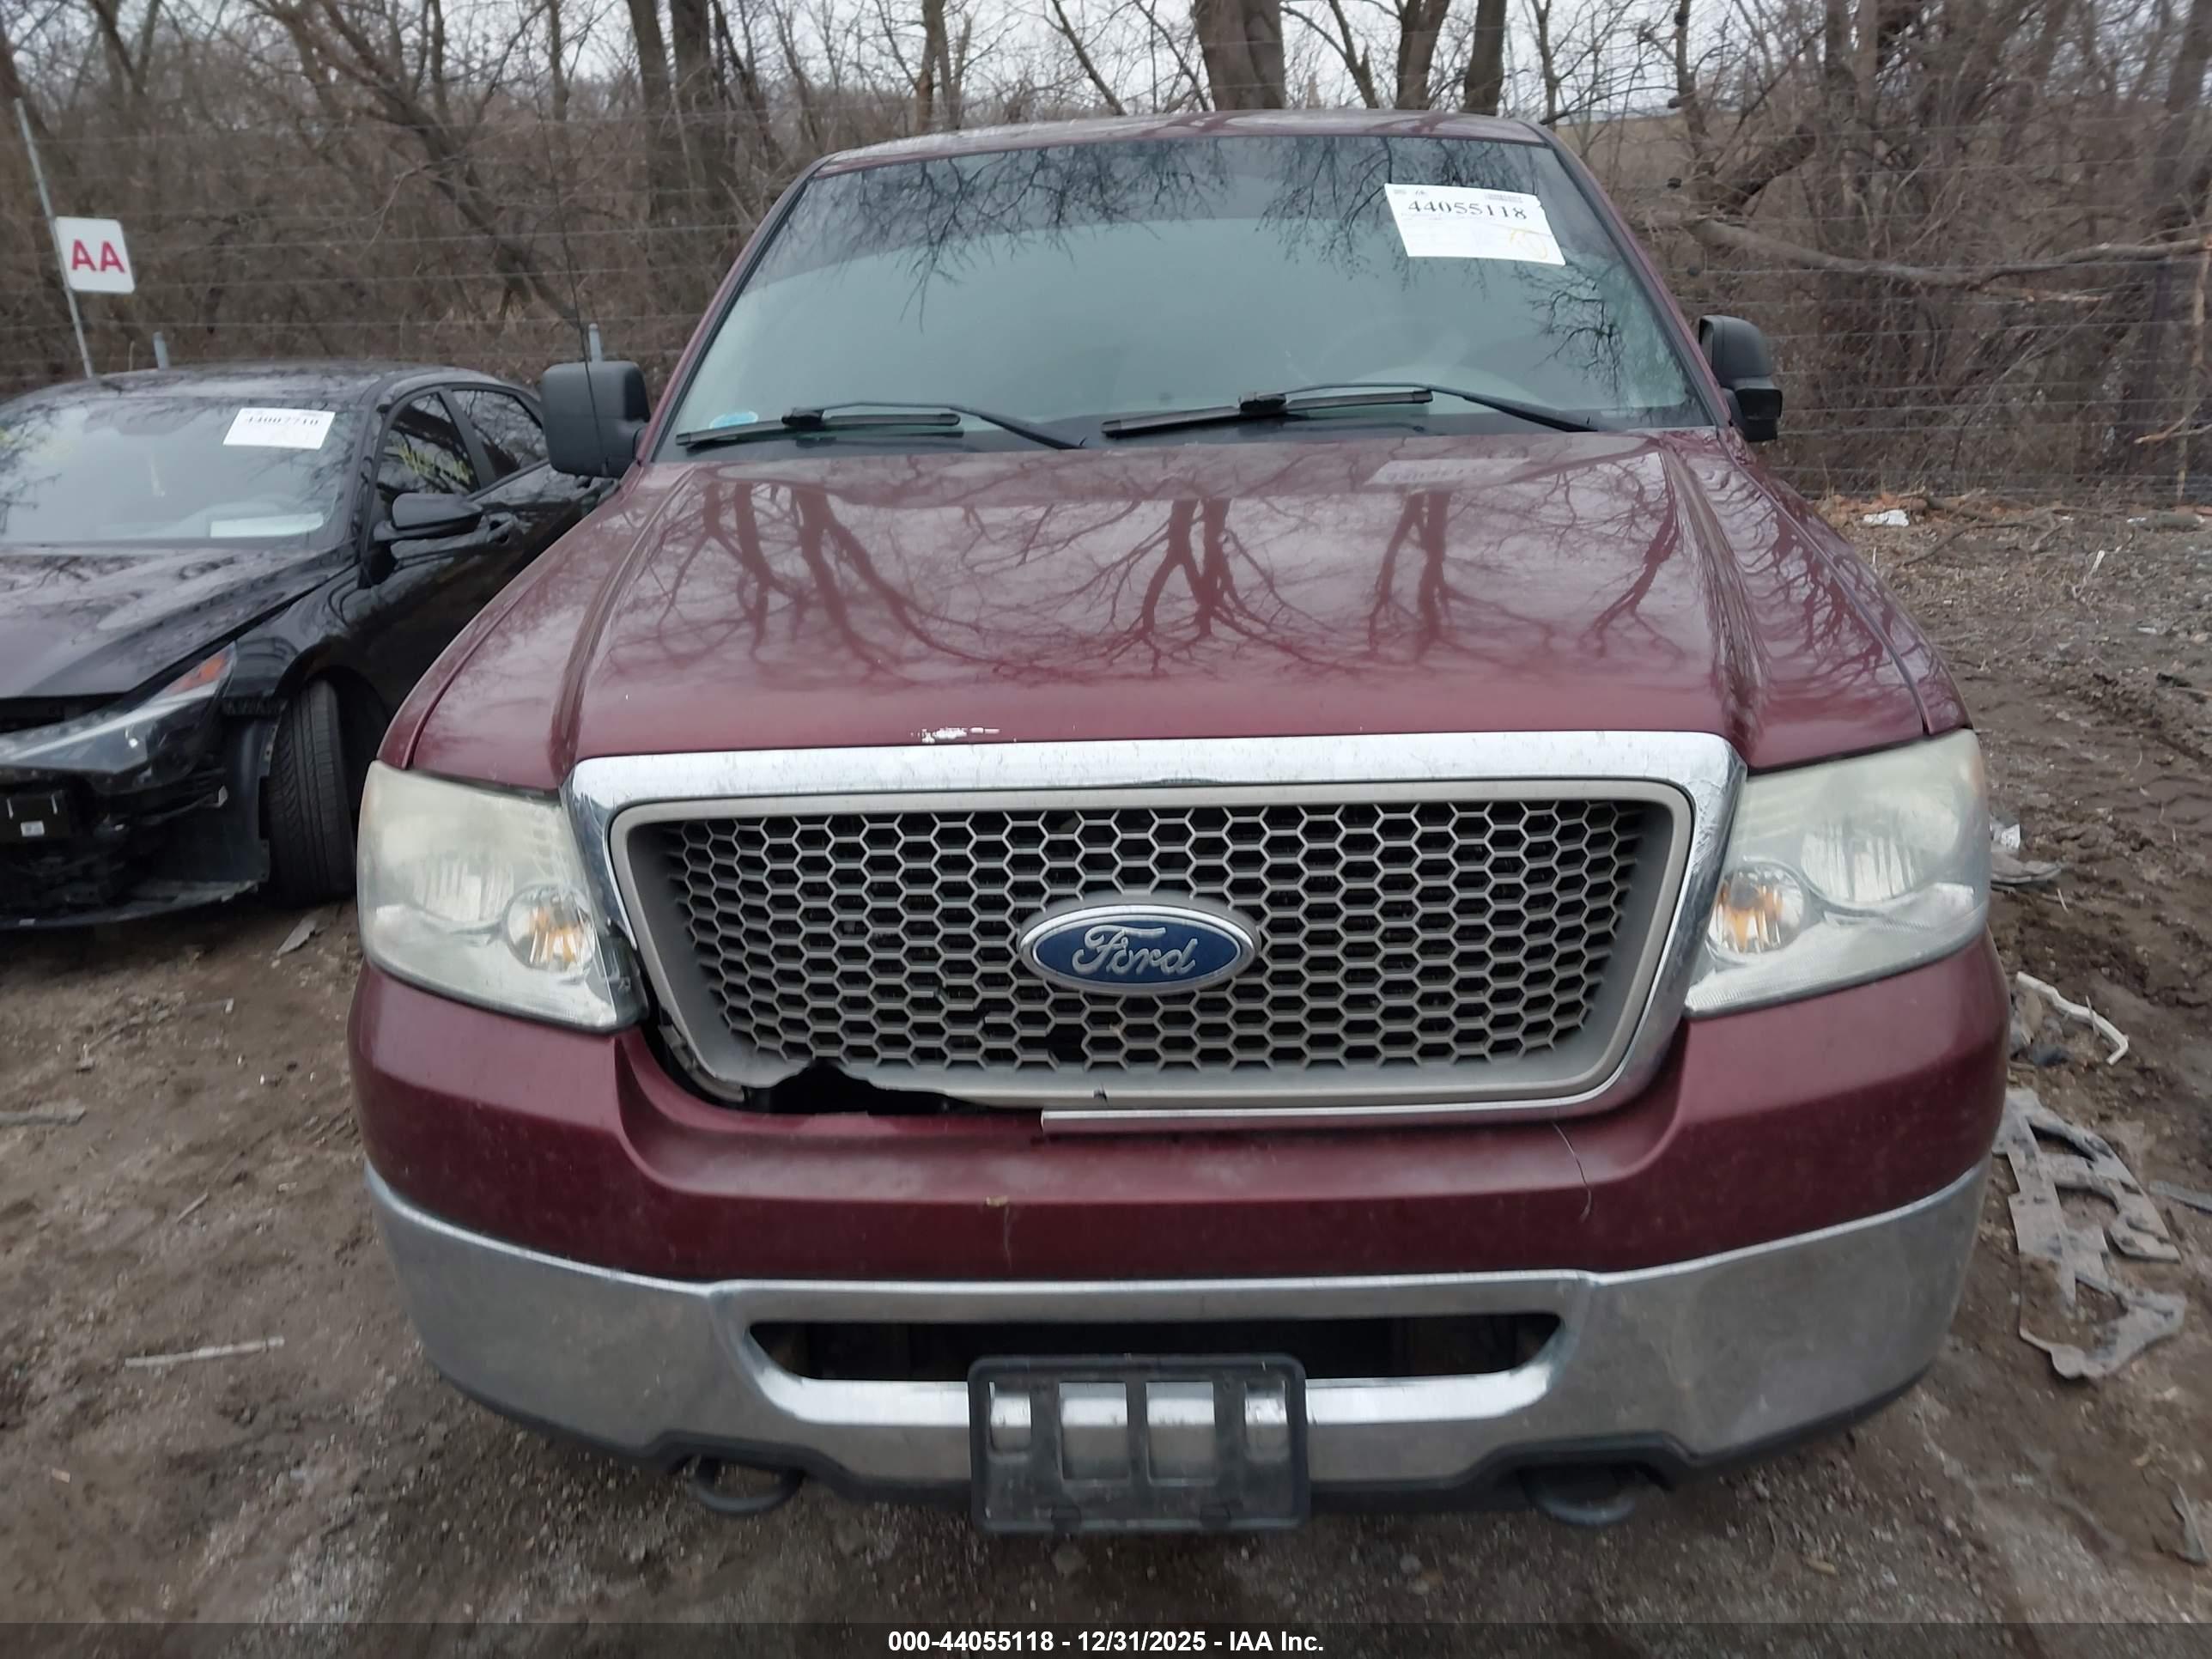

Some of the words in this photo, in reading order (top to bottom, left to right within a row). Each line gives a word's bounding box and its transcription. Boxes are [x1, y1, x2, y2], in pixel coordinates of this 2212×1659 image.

[1408, 200, 1527, 220] 44055118
[71, 239, 125, 273] AA
[1073, 925, 1198, 975] Ford
